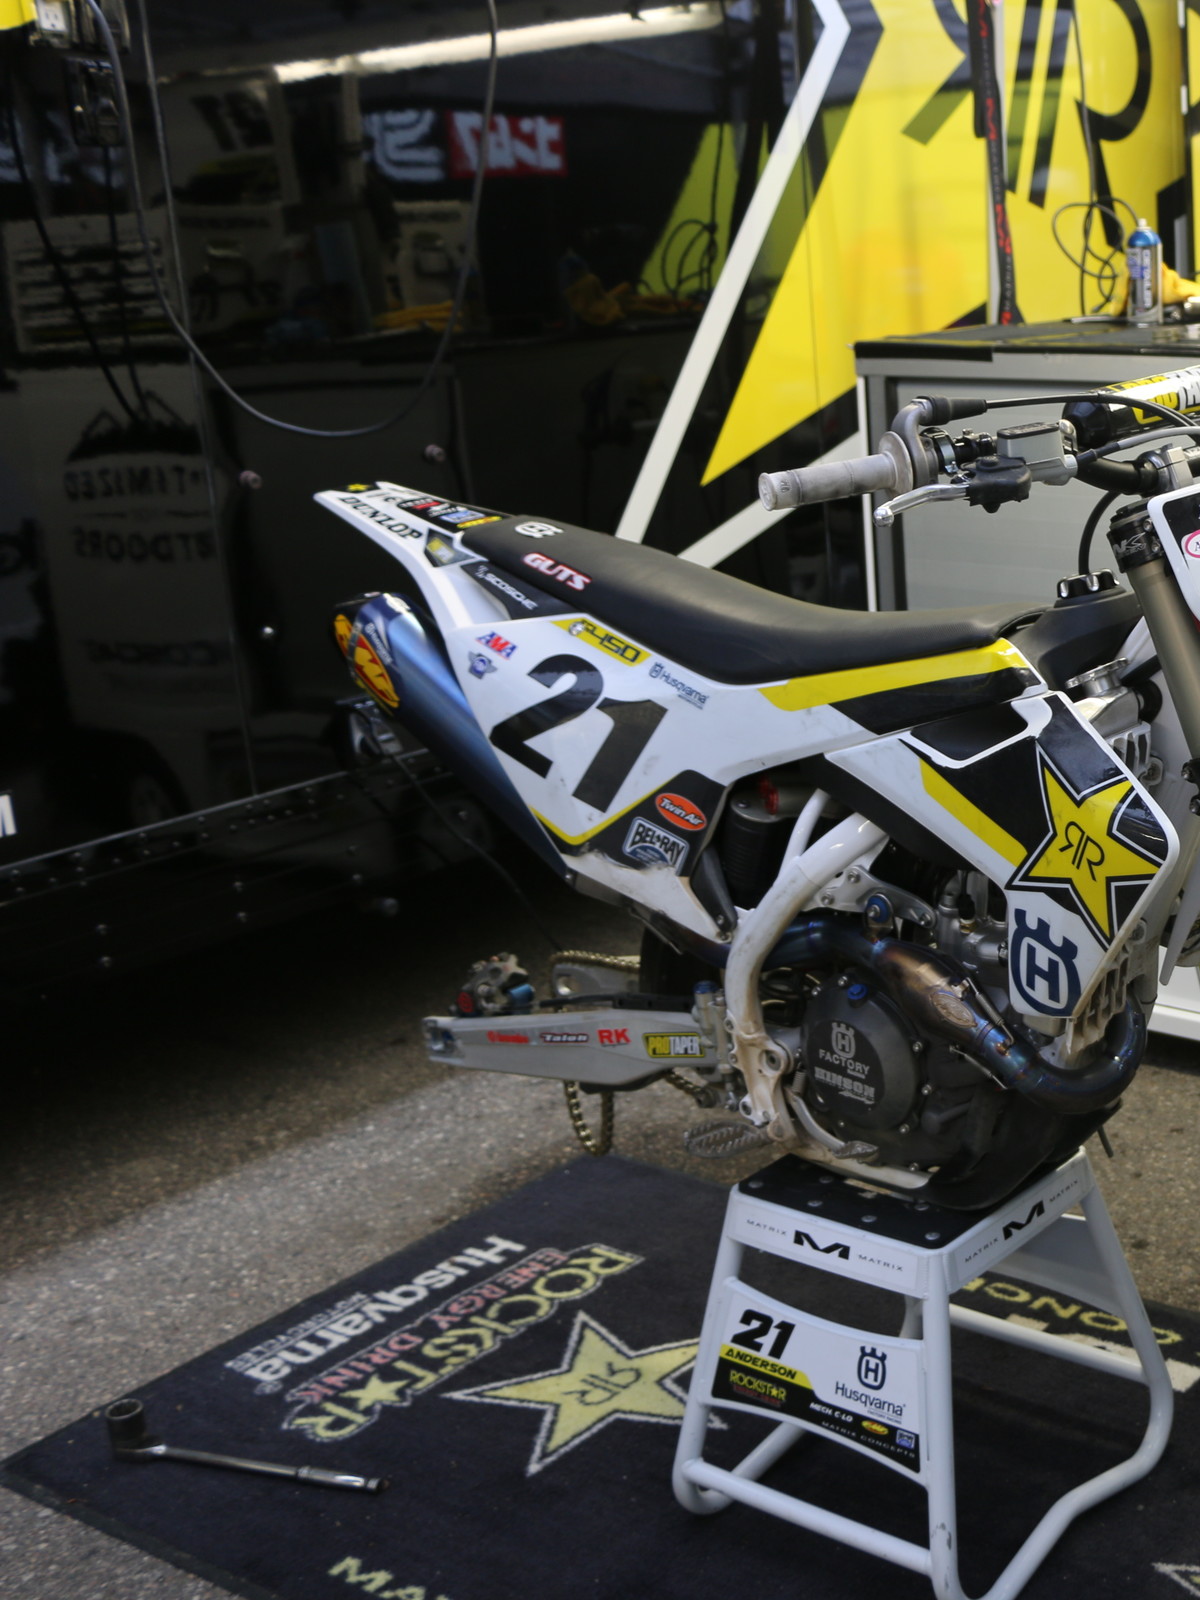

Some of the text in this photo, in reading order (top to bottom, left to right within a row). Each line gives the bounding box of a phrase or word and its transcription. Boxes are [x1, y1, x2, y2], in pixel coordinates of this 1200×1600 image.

[340, 495, 424, 540] DUNLOP
[521, 551, 594, 592] GUTS
[660, 670, 709, 705] Husqvarna
[489, 652, 668, 814] 21
[660, 797, 704, 826] Twin Air
[597, 1028, 632, 1044] RK
[818, 1047, 871, 1076] FACTORY
[746, 1219, 788, 1237] MATRIX
[858, 1253, 904, 1272] MATRIX
[964, 1236, 999, 1263] MATRIX
[244, 1235, 527, 1383] Husqvarna
[730, 1308, 797, 1360] 21
[725, 1347, 798, 1380] ANDERSON
[835, 1380, 905, 1417] Husqvarna
[834, 1410, 854, 1423] C-LO
